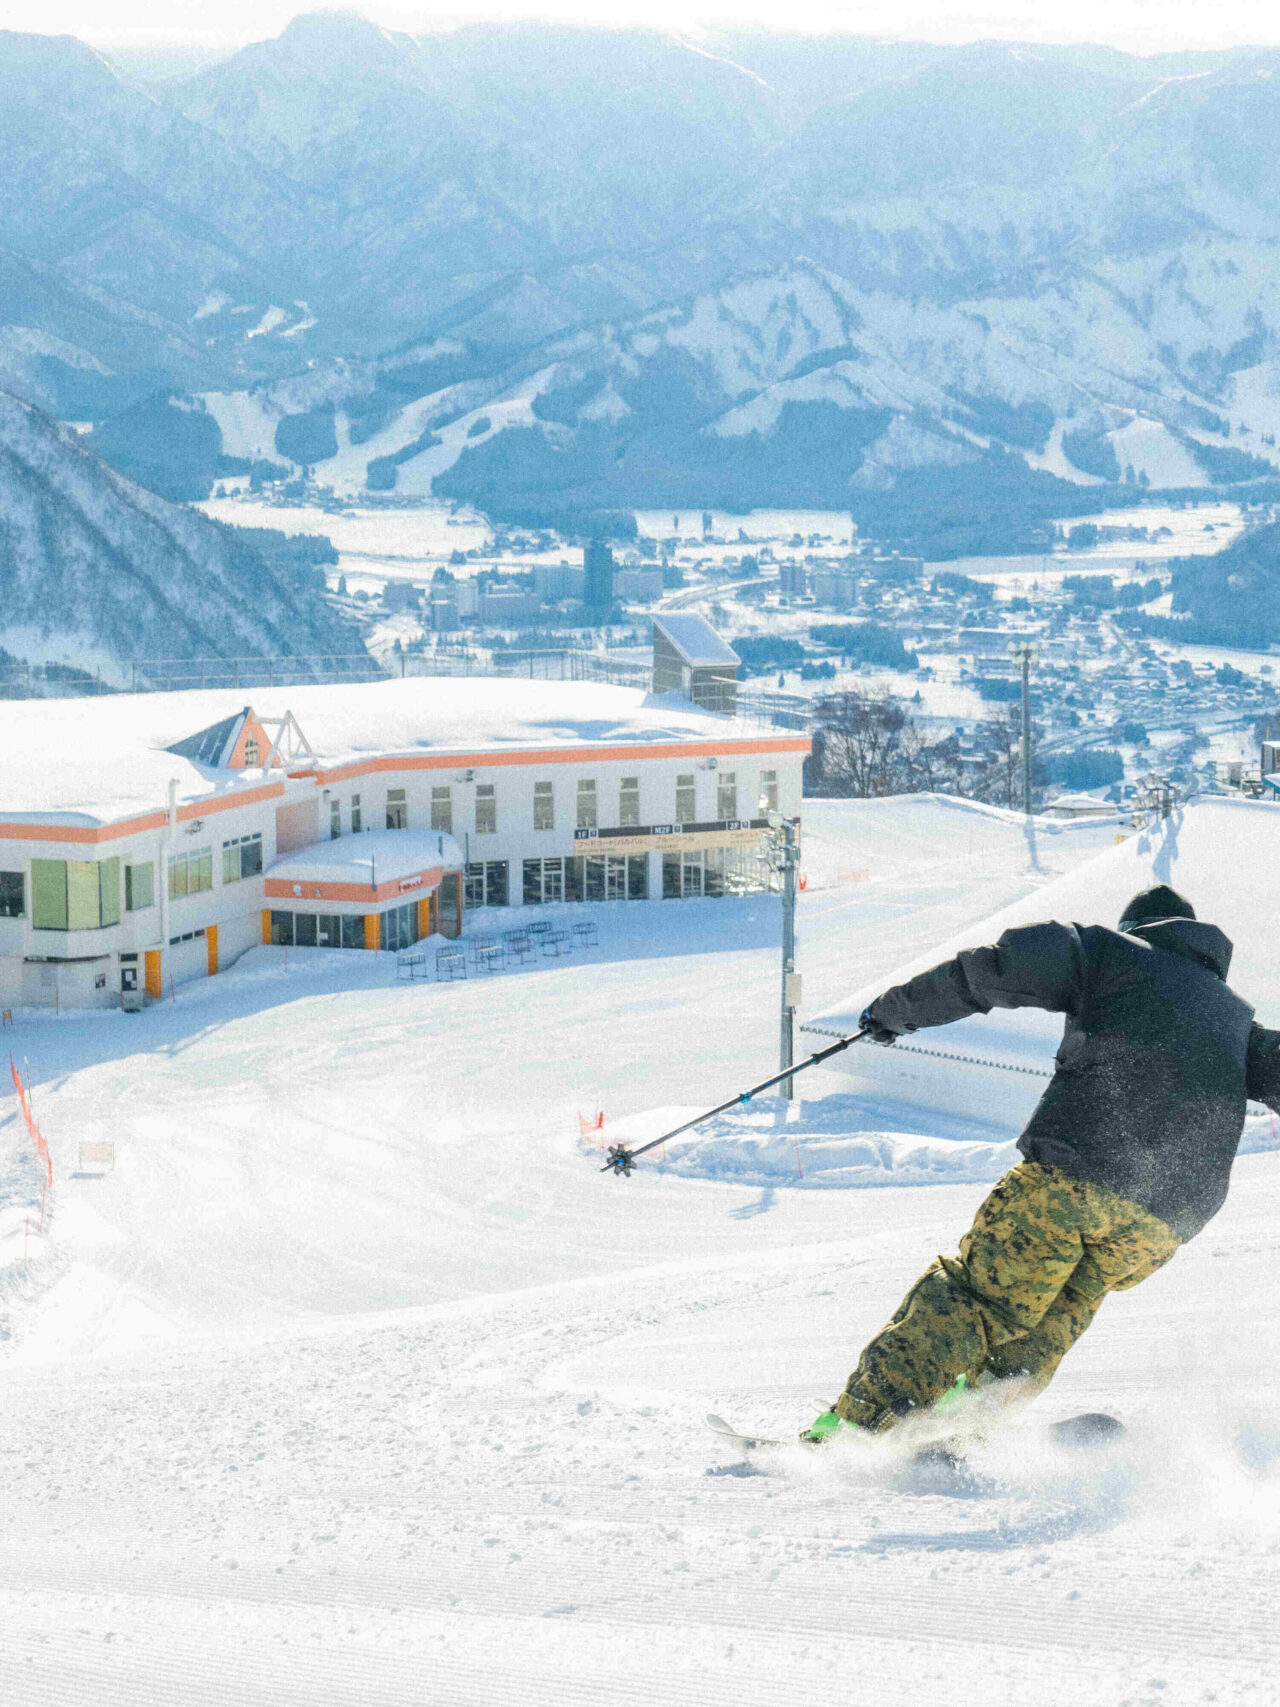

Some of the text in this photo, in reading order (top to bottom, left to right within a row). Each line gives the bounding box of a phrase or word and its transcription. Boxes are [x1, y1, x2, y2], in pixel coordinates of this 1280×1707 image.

[654, 826, 671, 834] M2F
[730, 822, 740, 830] 2F
[577, 831, 587, 839] 1F
